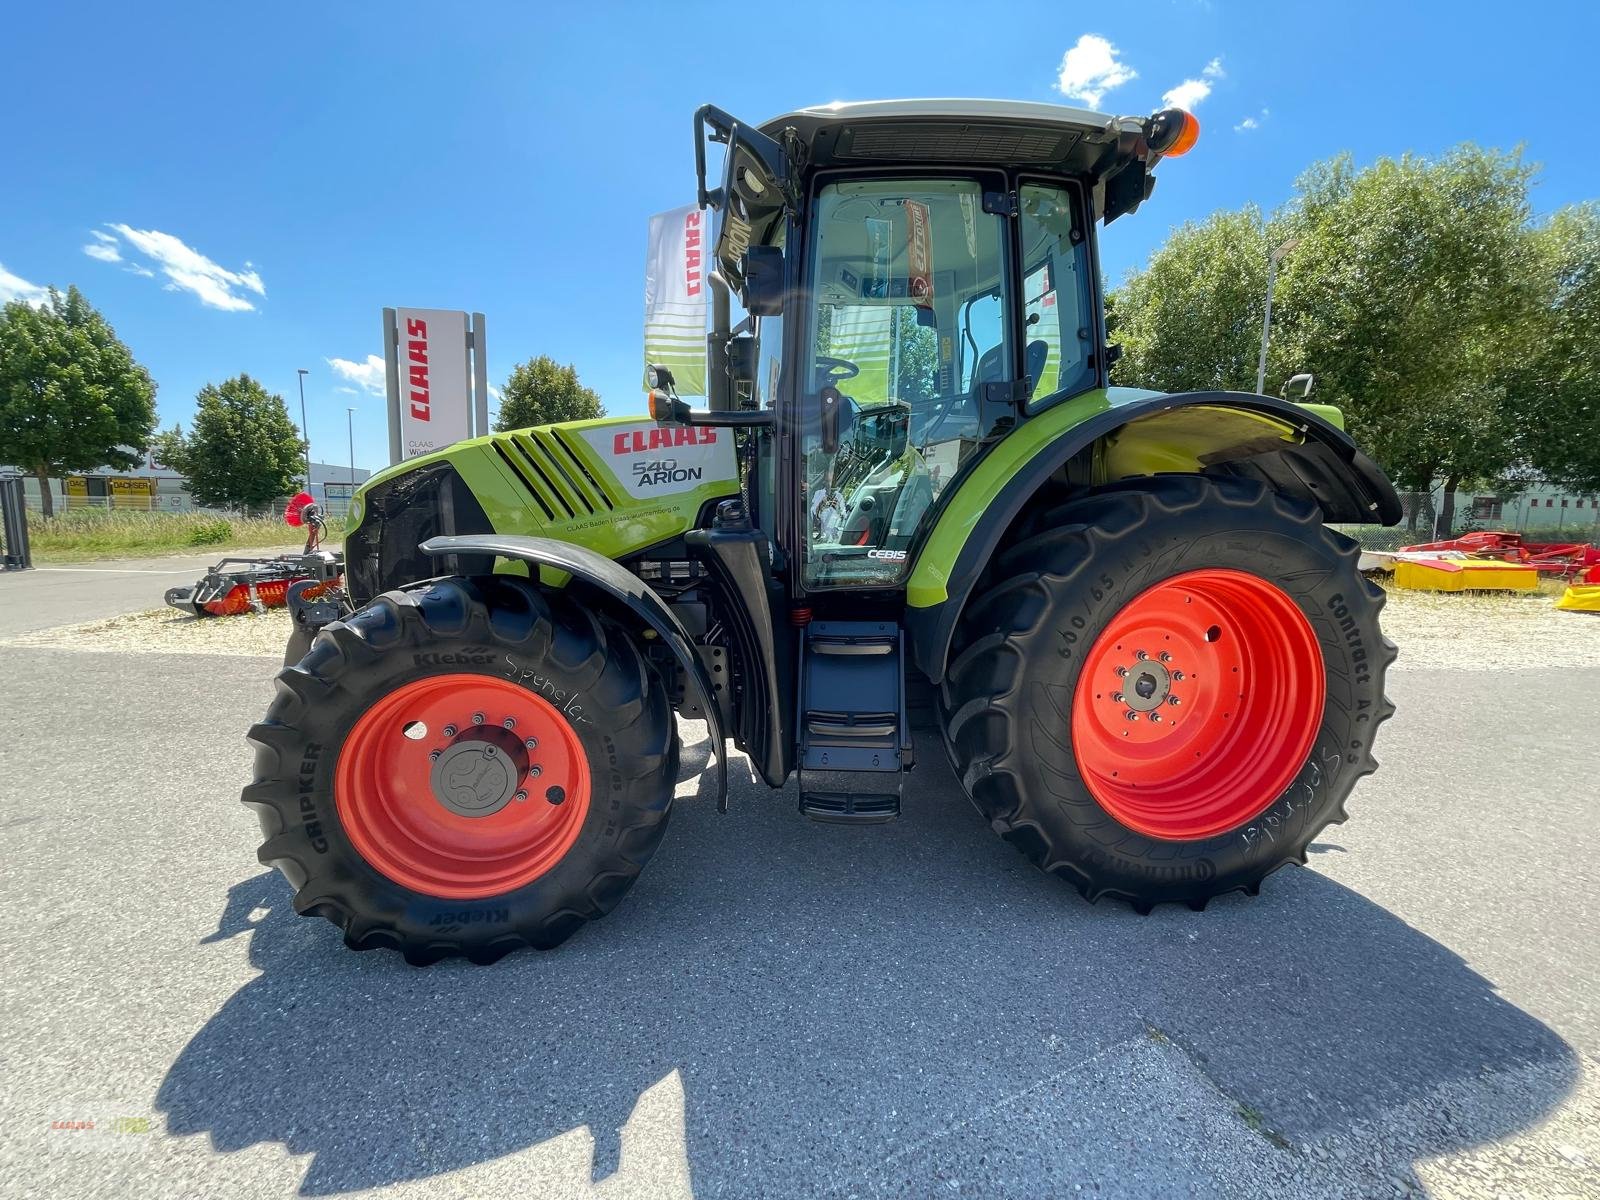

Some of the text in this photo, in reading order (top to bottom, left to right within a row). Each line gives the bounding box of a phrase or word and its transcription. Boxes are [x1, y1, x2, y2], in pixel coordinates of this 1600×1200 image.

[728, 216, 752, 262] ARION
[407, 317, 430, 422] CLAAS
[409, 440, 433, 448] CLAAS
[613, 426, 717, 455] CLAAS
[632, 459, 678, 475] 540
[638, 467, 702, 487] ARION
[566, 523, 592, 532] CLAAS
[590, 519, 609, 528] Baden
[867, 549, 907, 560] CEBIS
[1326, 593, 1371, 685] Contract
[412, 650, 498, 666] Kleber
[1346, 739, 1364, 766] 65
[300, 742, 329, 855] GRIPKER
[428, 909, 511, 926] Kleber
